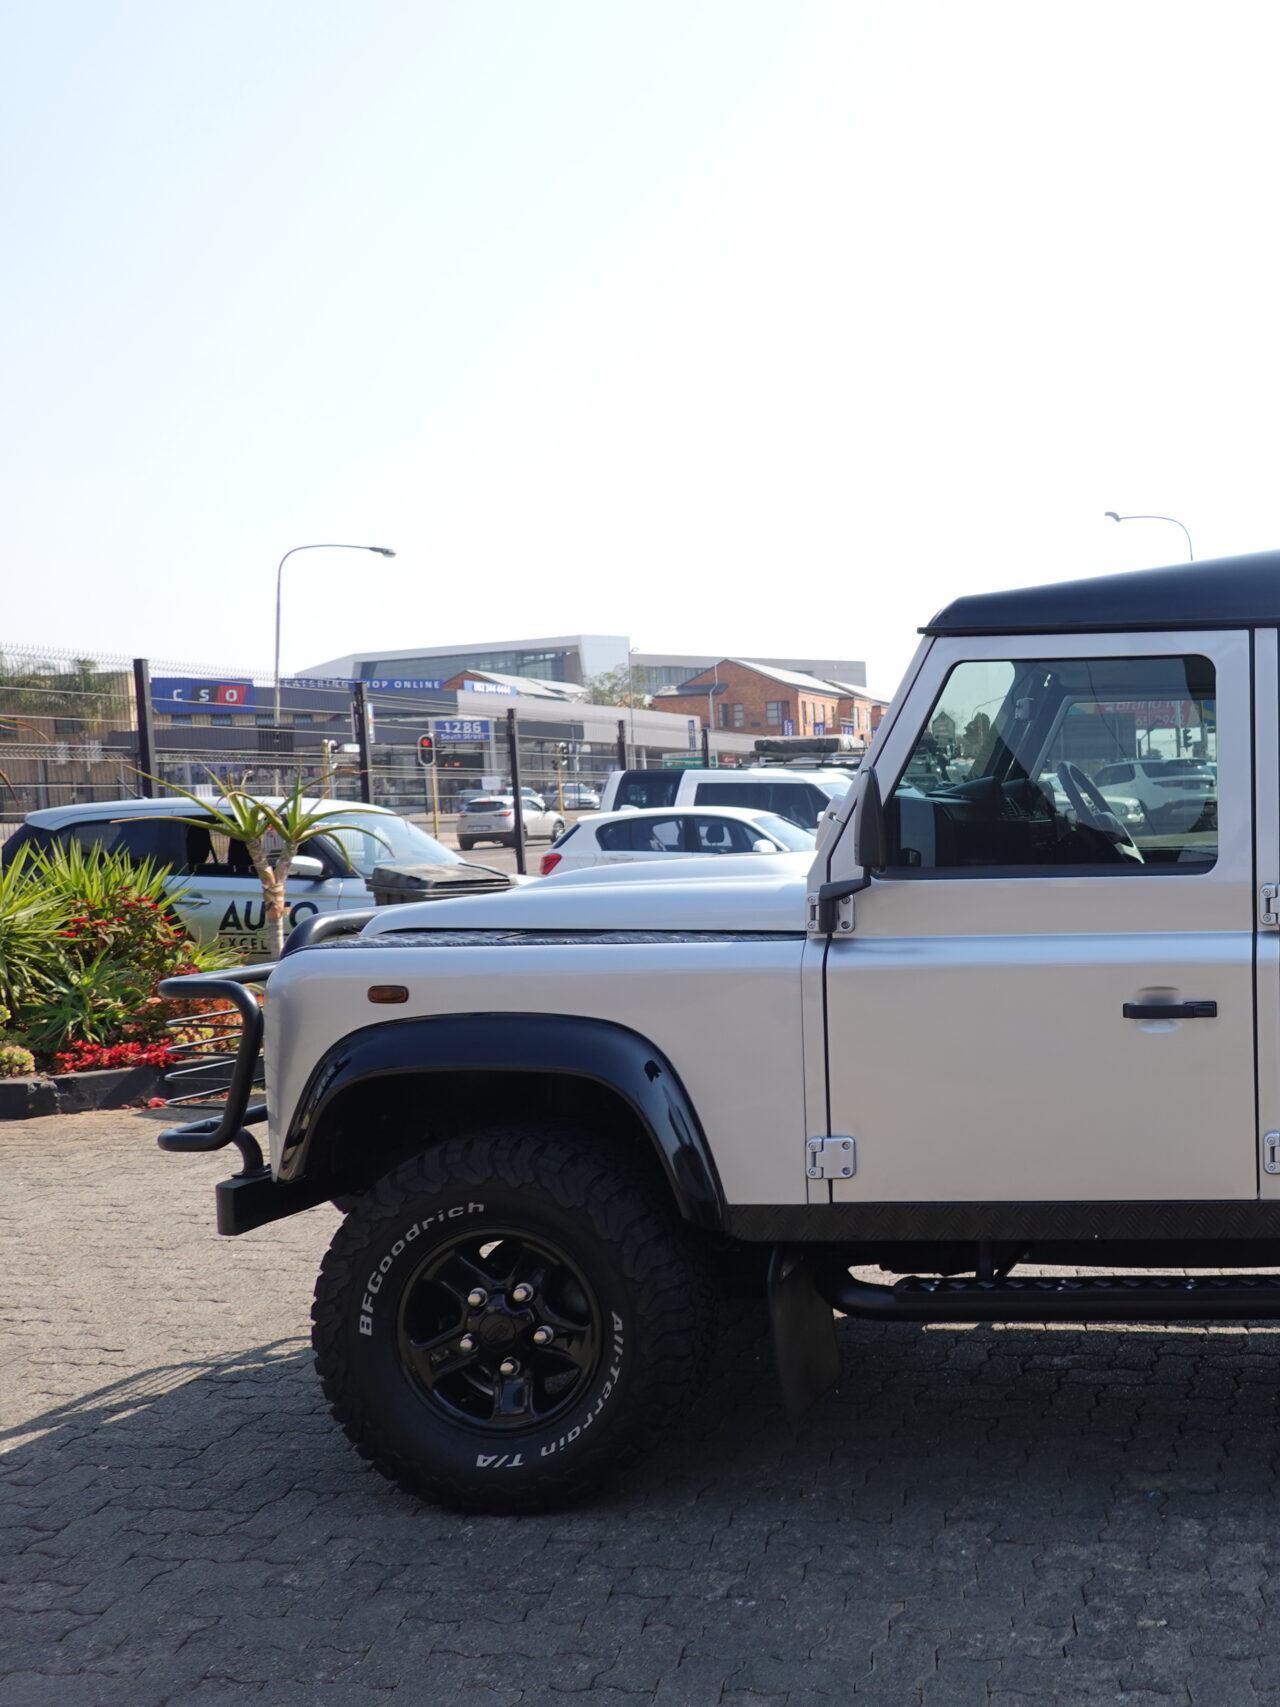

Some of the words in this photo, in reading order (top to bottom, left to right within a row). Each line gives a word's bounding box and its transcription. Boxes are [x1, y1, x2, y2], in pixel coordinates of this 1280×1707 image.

[364, 680, 388, 689] HOP
[394, 680, 440, 689] ONLINE
[444, 721, 481, 733] 1286
[219, 900, 319, 931] AUO
[359, 1201, 485, 1336] BFGoodrich
[540, 1311, 624, 1457] All-Terrain
[476, 1453, 525, 1468] T/A
